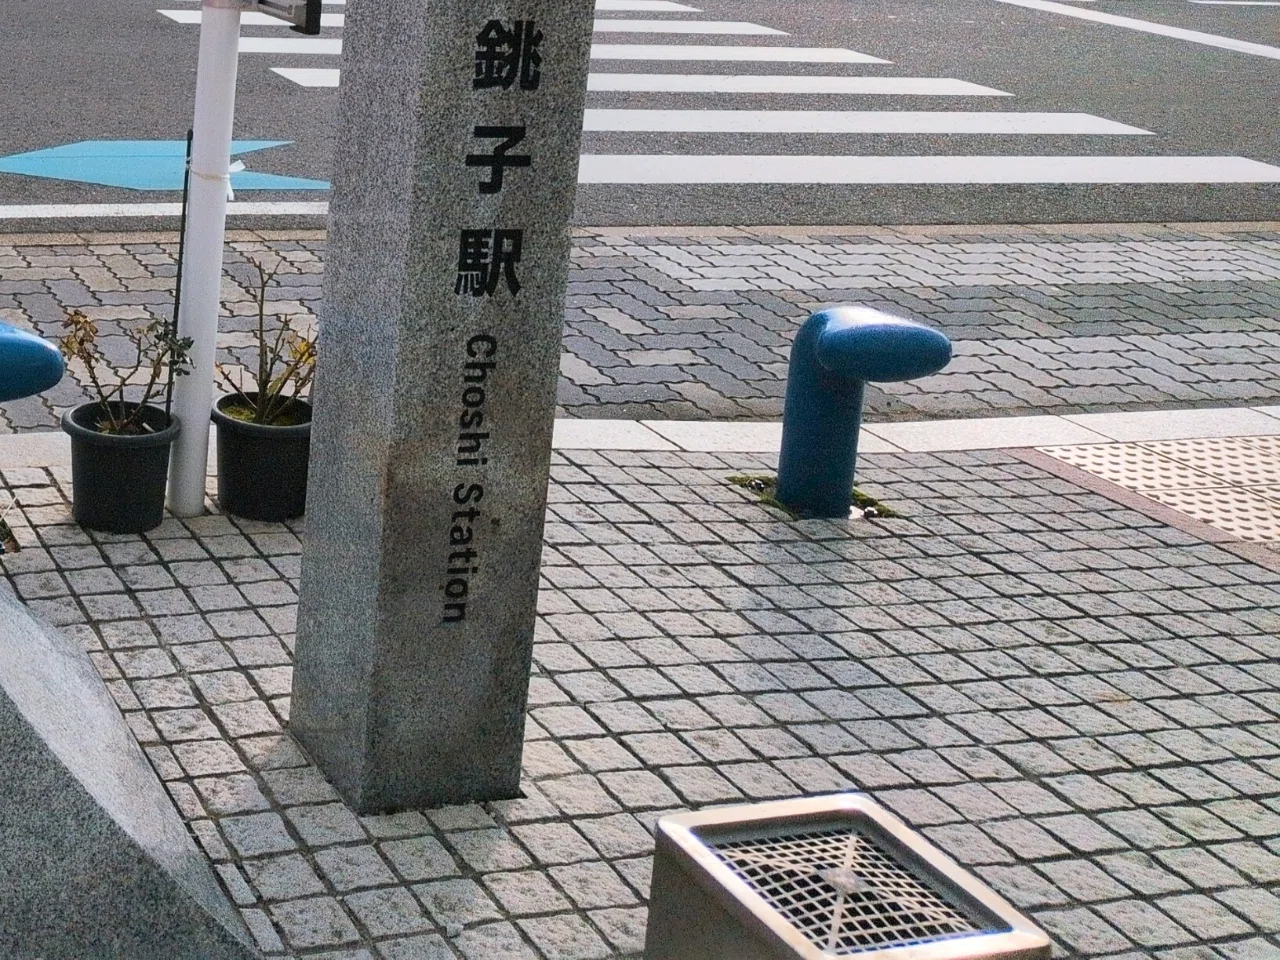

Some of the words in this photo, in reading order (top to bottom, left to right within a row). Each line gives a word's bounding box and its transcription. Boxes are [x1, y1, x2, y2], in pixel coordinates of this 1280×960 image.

[454, 19, 544, 298] 銚子駅
[456, 334, 498, 466] Choshi
[442, 482, 485, 623] Station
